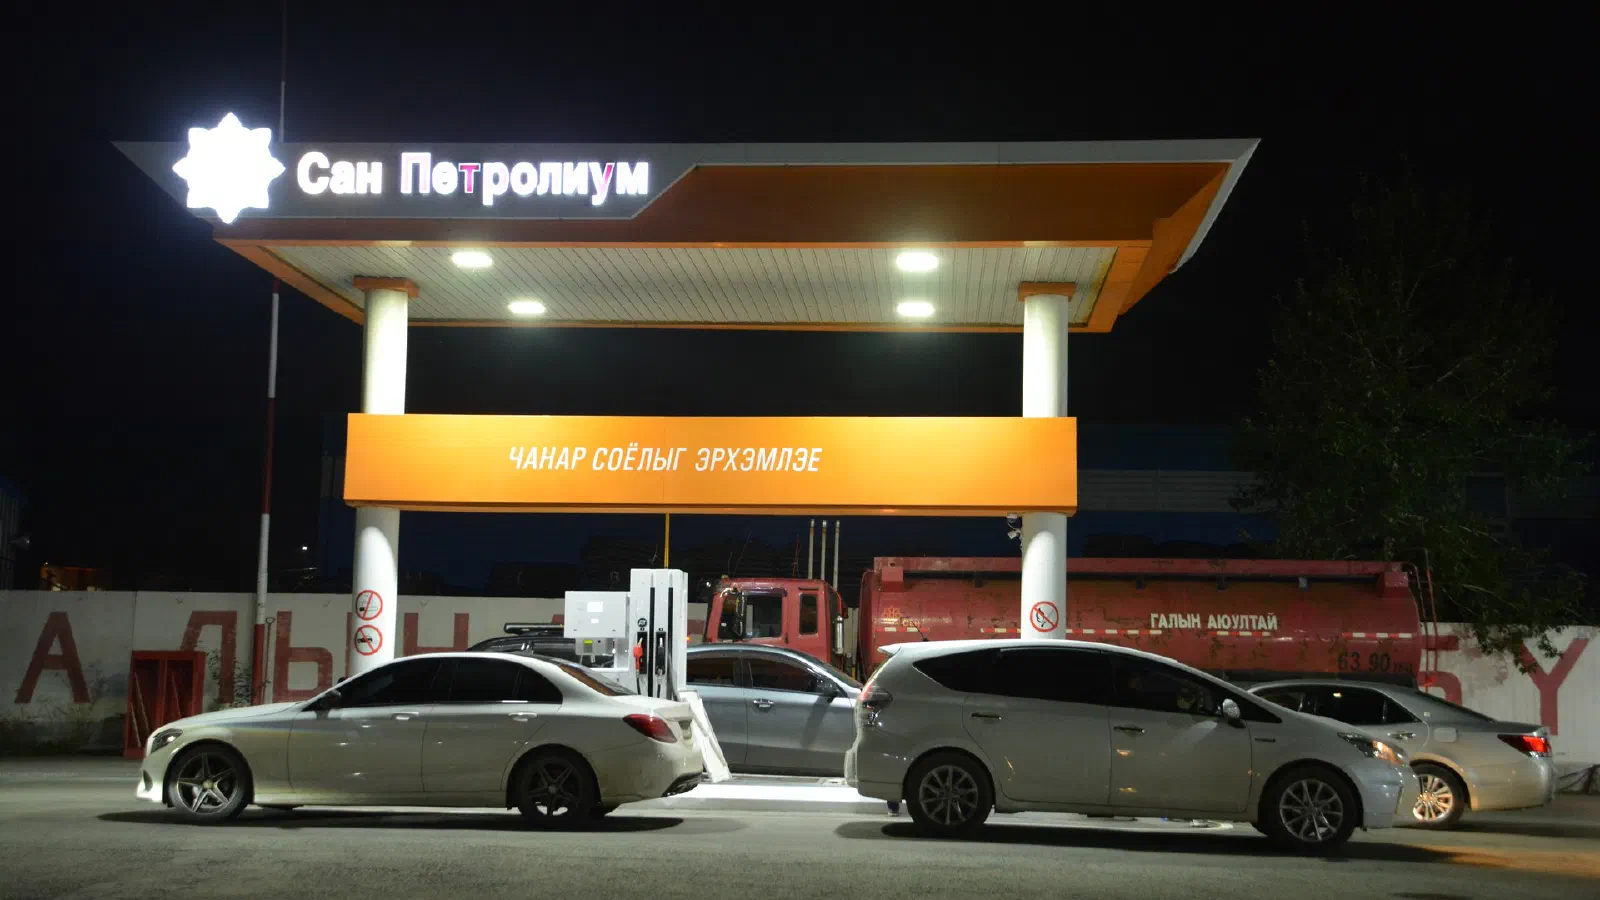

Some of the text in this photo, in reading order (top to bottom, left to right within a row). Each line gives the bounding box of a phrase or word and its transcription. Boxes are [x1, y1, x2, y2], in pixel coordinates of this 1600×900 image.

[297, 151, 649, 206] Сан Петролиум
[509, 442, 822, 472] ЧАНАР СОЁЛЫГ ЭРХЭМЛЭЕ
[1150, 612, 1278, 630] ГАЛЫН АЮУЛТАЙ
[1338, 651, 1360, 672] 63
[1369, 651, 1391, 673] 90
